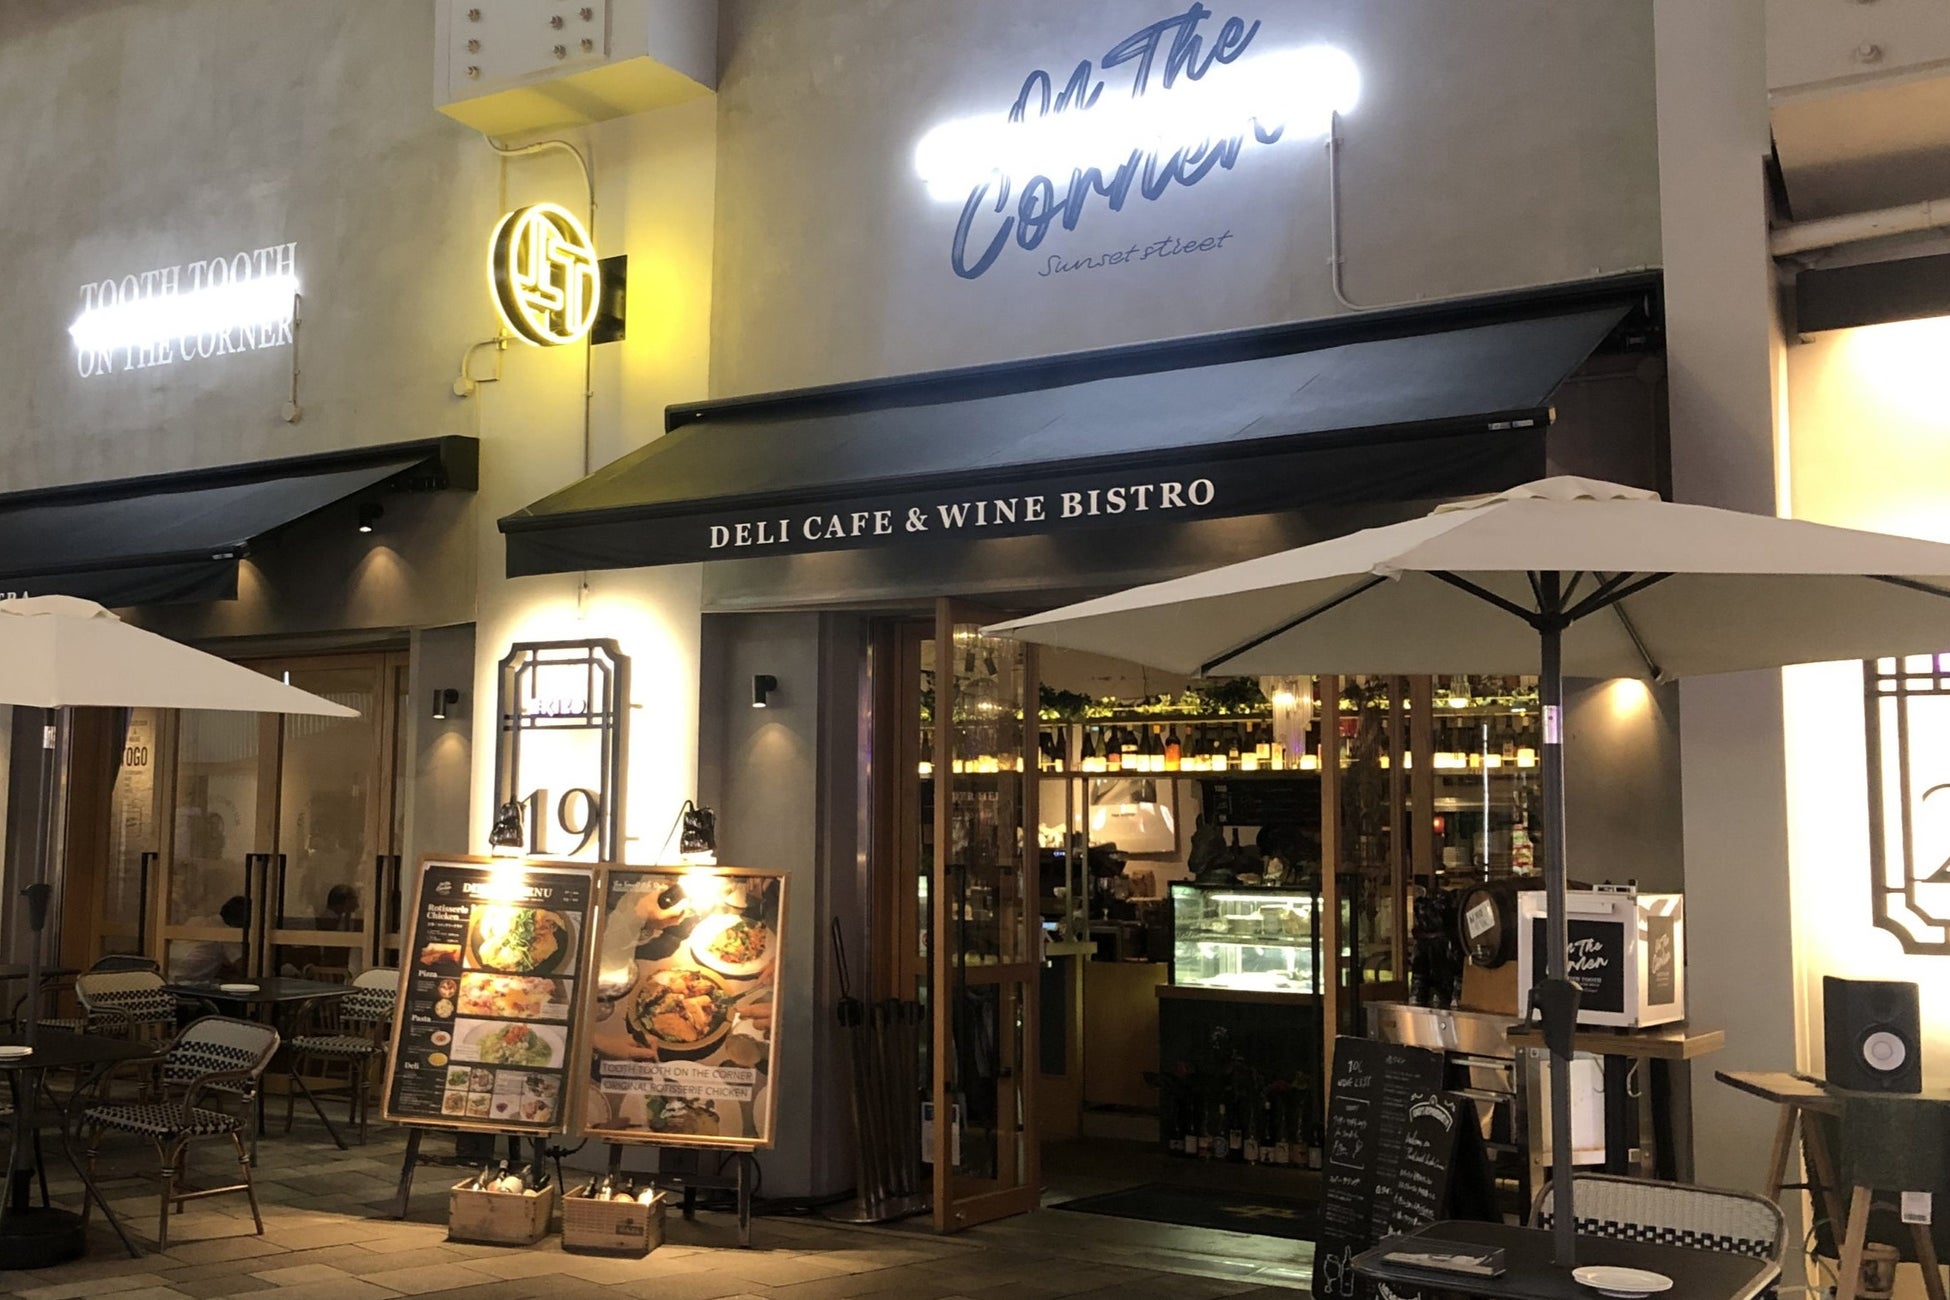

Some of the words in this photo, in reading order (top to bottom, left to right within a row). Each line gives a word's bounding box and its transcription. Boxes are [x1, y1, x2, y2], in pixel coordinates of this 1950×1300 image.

[1101, 2, 1262, 98] The
[80, 265, 182, 314] TOOTH
[188, 242, 298, 293] TOOTH
[76, 342, 112, 378] ON
[124, 334, 172, 371] THE
[180, 316, 294, 361] CORNER
[709, 518, 790, 549] DELI
[802, 510, 894, 541] CAFE
[904, 507, 929, 533] &
[936, 495, 1046, 530] WINE
[1059, 478, 1216, 519] BISTRO
[122, 746, 148, 767] OGO
[522, 787, 600, 857] 19
[426, 911, 460, 921] Chicken
[1575, 937, 1604, 957] The
[418, 970, 438, 978] Pizza
[411, 1014, 432, 1022] Pasta
[637, 1066, 671, 1076] TOOTH
[673, 1067, 689, 1077] ON
[692, 1069, 710, 1078] THE
[712, 1069, 753, 1081] CORNER
[649, 1083, 703, 1096] ROTISSERIE
[705, 1086, 749, 1097] CHICKEN
